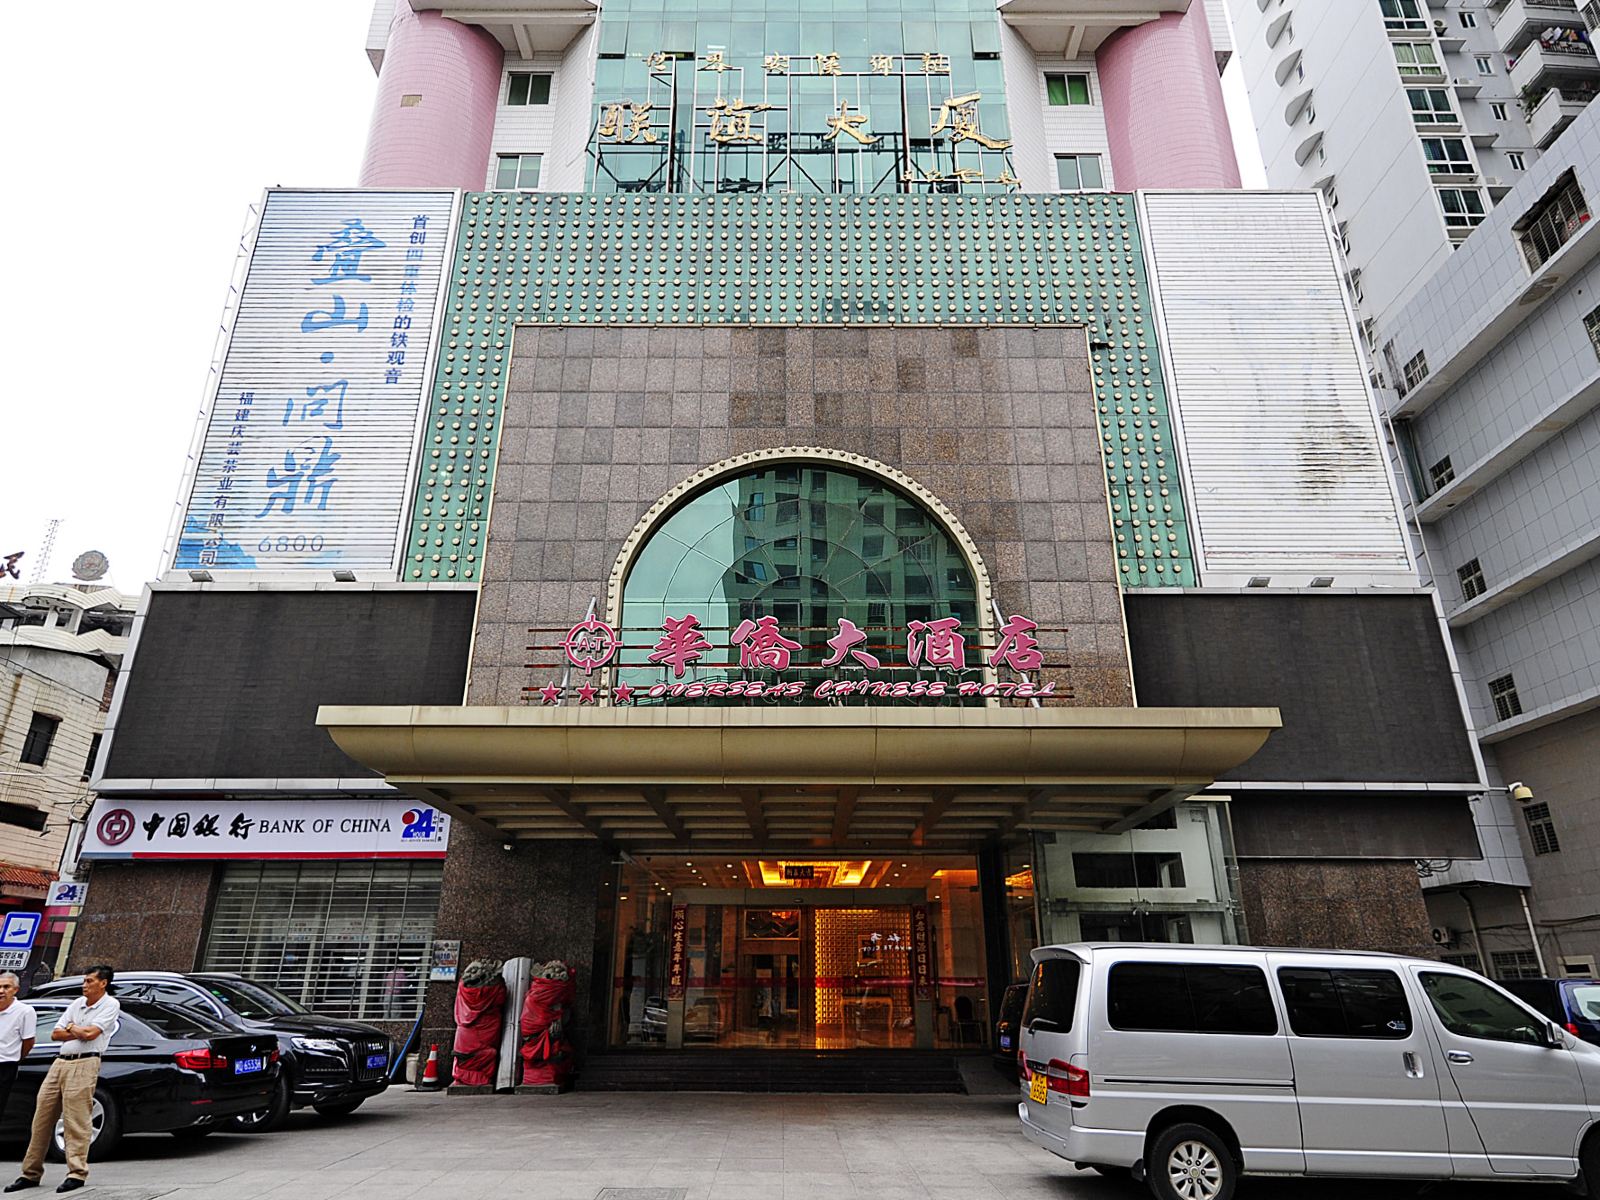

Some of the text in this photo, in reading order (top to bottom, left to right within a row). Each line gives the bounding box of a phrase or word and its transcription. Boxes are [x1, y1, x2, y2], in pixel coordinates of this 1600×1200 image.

[385, 214, 430, 385] 首创四重体检的铁观音
[258, 534, 325, 553] 6800
[647, 613, 1044, 678] 華僑大酒店
[648, 679, 1056, 699] OVERSEAS CHINESE HOTEL
[143, 812, 256, 841] 中国银行
[258, 818, 392, 834] BANK OF CHINA
[402, 808, 436, 839] 24
[56, 884, 78, 901] 24
